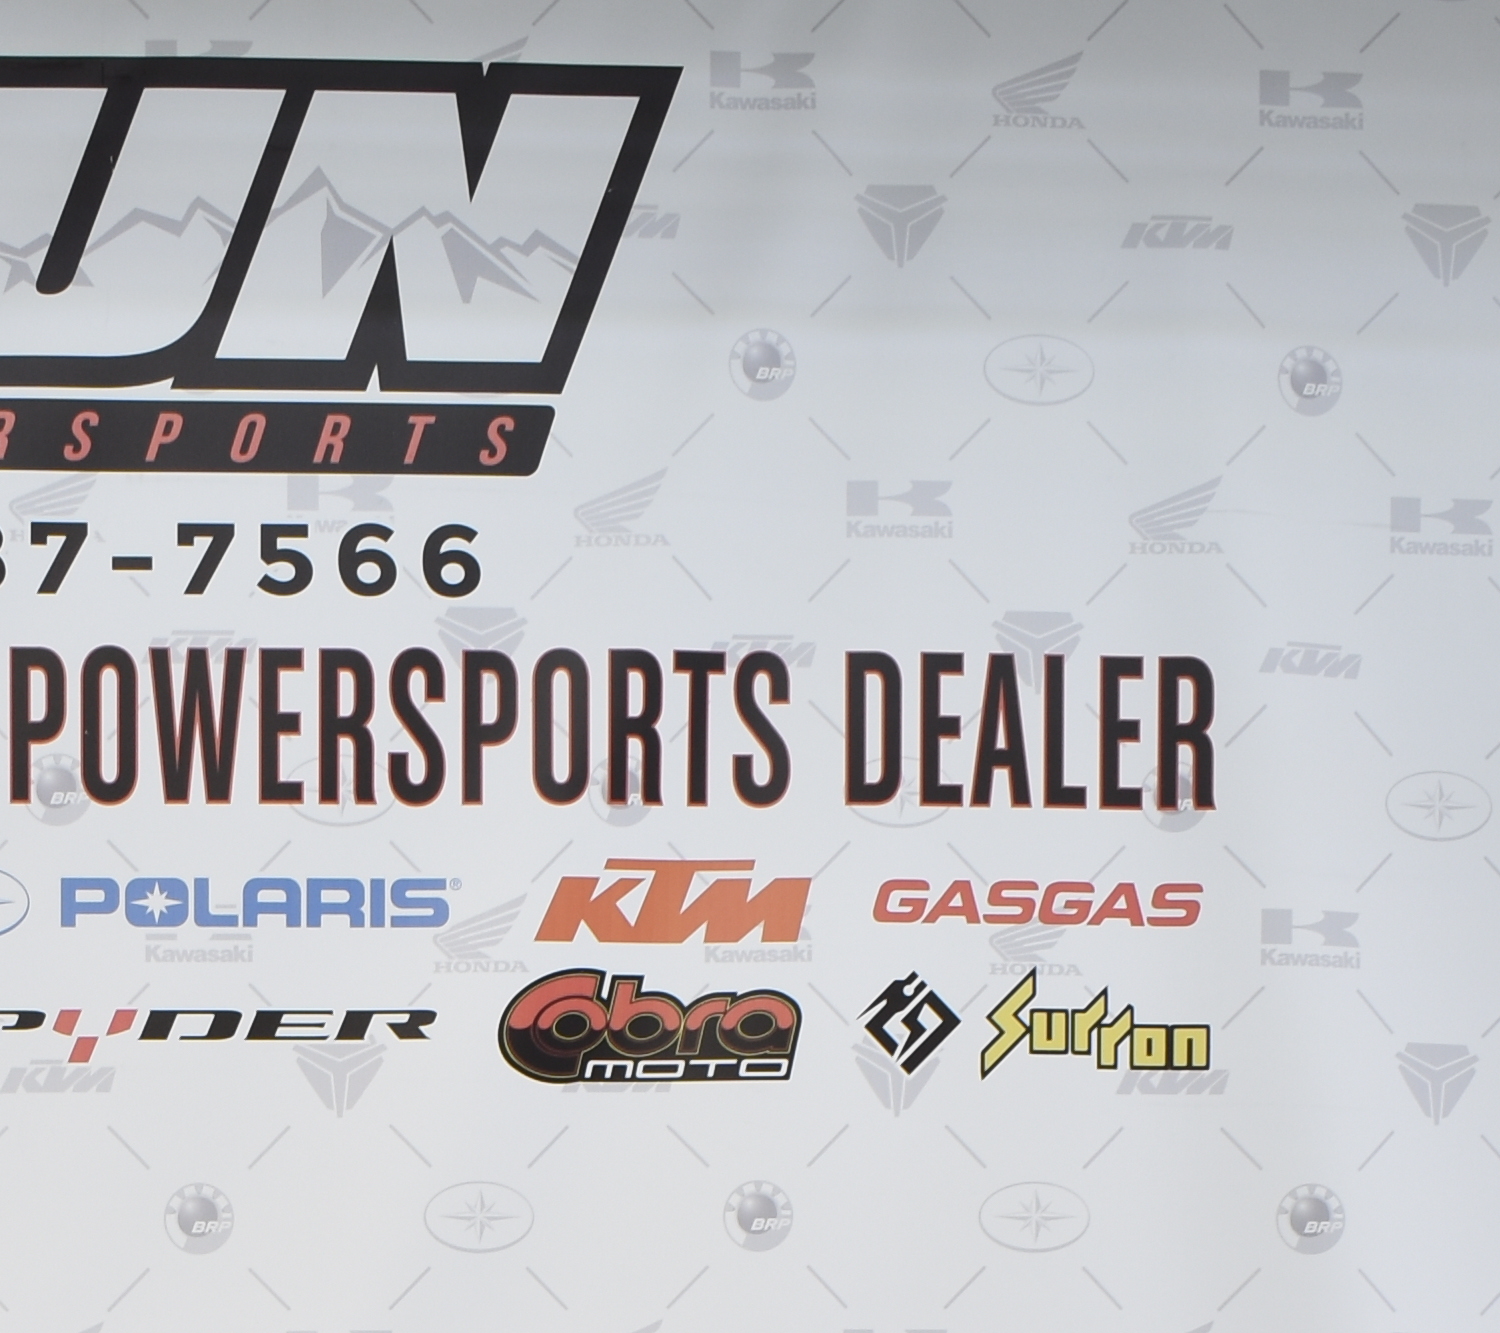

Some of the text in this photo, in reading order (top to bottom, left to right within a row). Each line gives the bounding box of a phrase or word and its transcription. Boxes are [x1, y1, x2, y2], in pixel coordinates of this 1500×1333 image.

[710, 92, 817, 111] Kawasaki
[993, 112, 1085, 129] HONDA
[1259, 107, 1363, 130] Kawasaki
[1122, 214, 1233, 250] KTM
[757, 367, 792, 378] BRP
[846, 521, 953, 538] Kawasaki
[575, 532, 670, 547] HONDA
[1130, 539, 1223, 555] HONDA
[1390, 537, 1493, 557] Kawasaki
[1259, 642, 1362, 679] KTM
[9, 644, 791, 807] POWERSPORTS
[845, 650, 1216, 811] DEALER
[61, 877, 450, 928] POLARIS
[534, 859, 811, 944] KTM
[873, 879, 1204, 927] GASGAS
[145, 945, 253, 962] Kawasaki
[703, 942, 812, 963] Kawasaki
[1260, 946, 1360, 968] Kawasaki
[434, 958, 529, 973] HONDA
[988, 961, 1083, 976] HONDA
[751, 1217, 790, 1230] BRP
